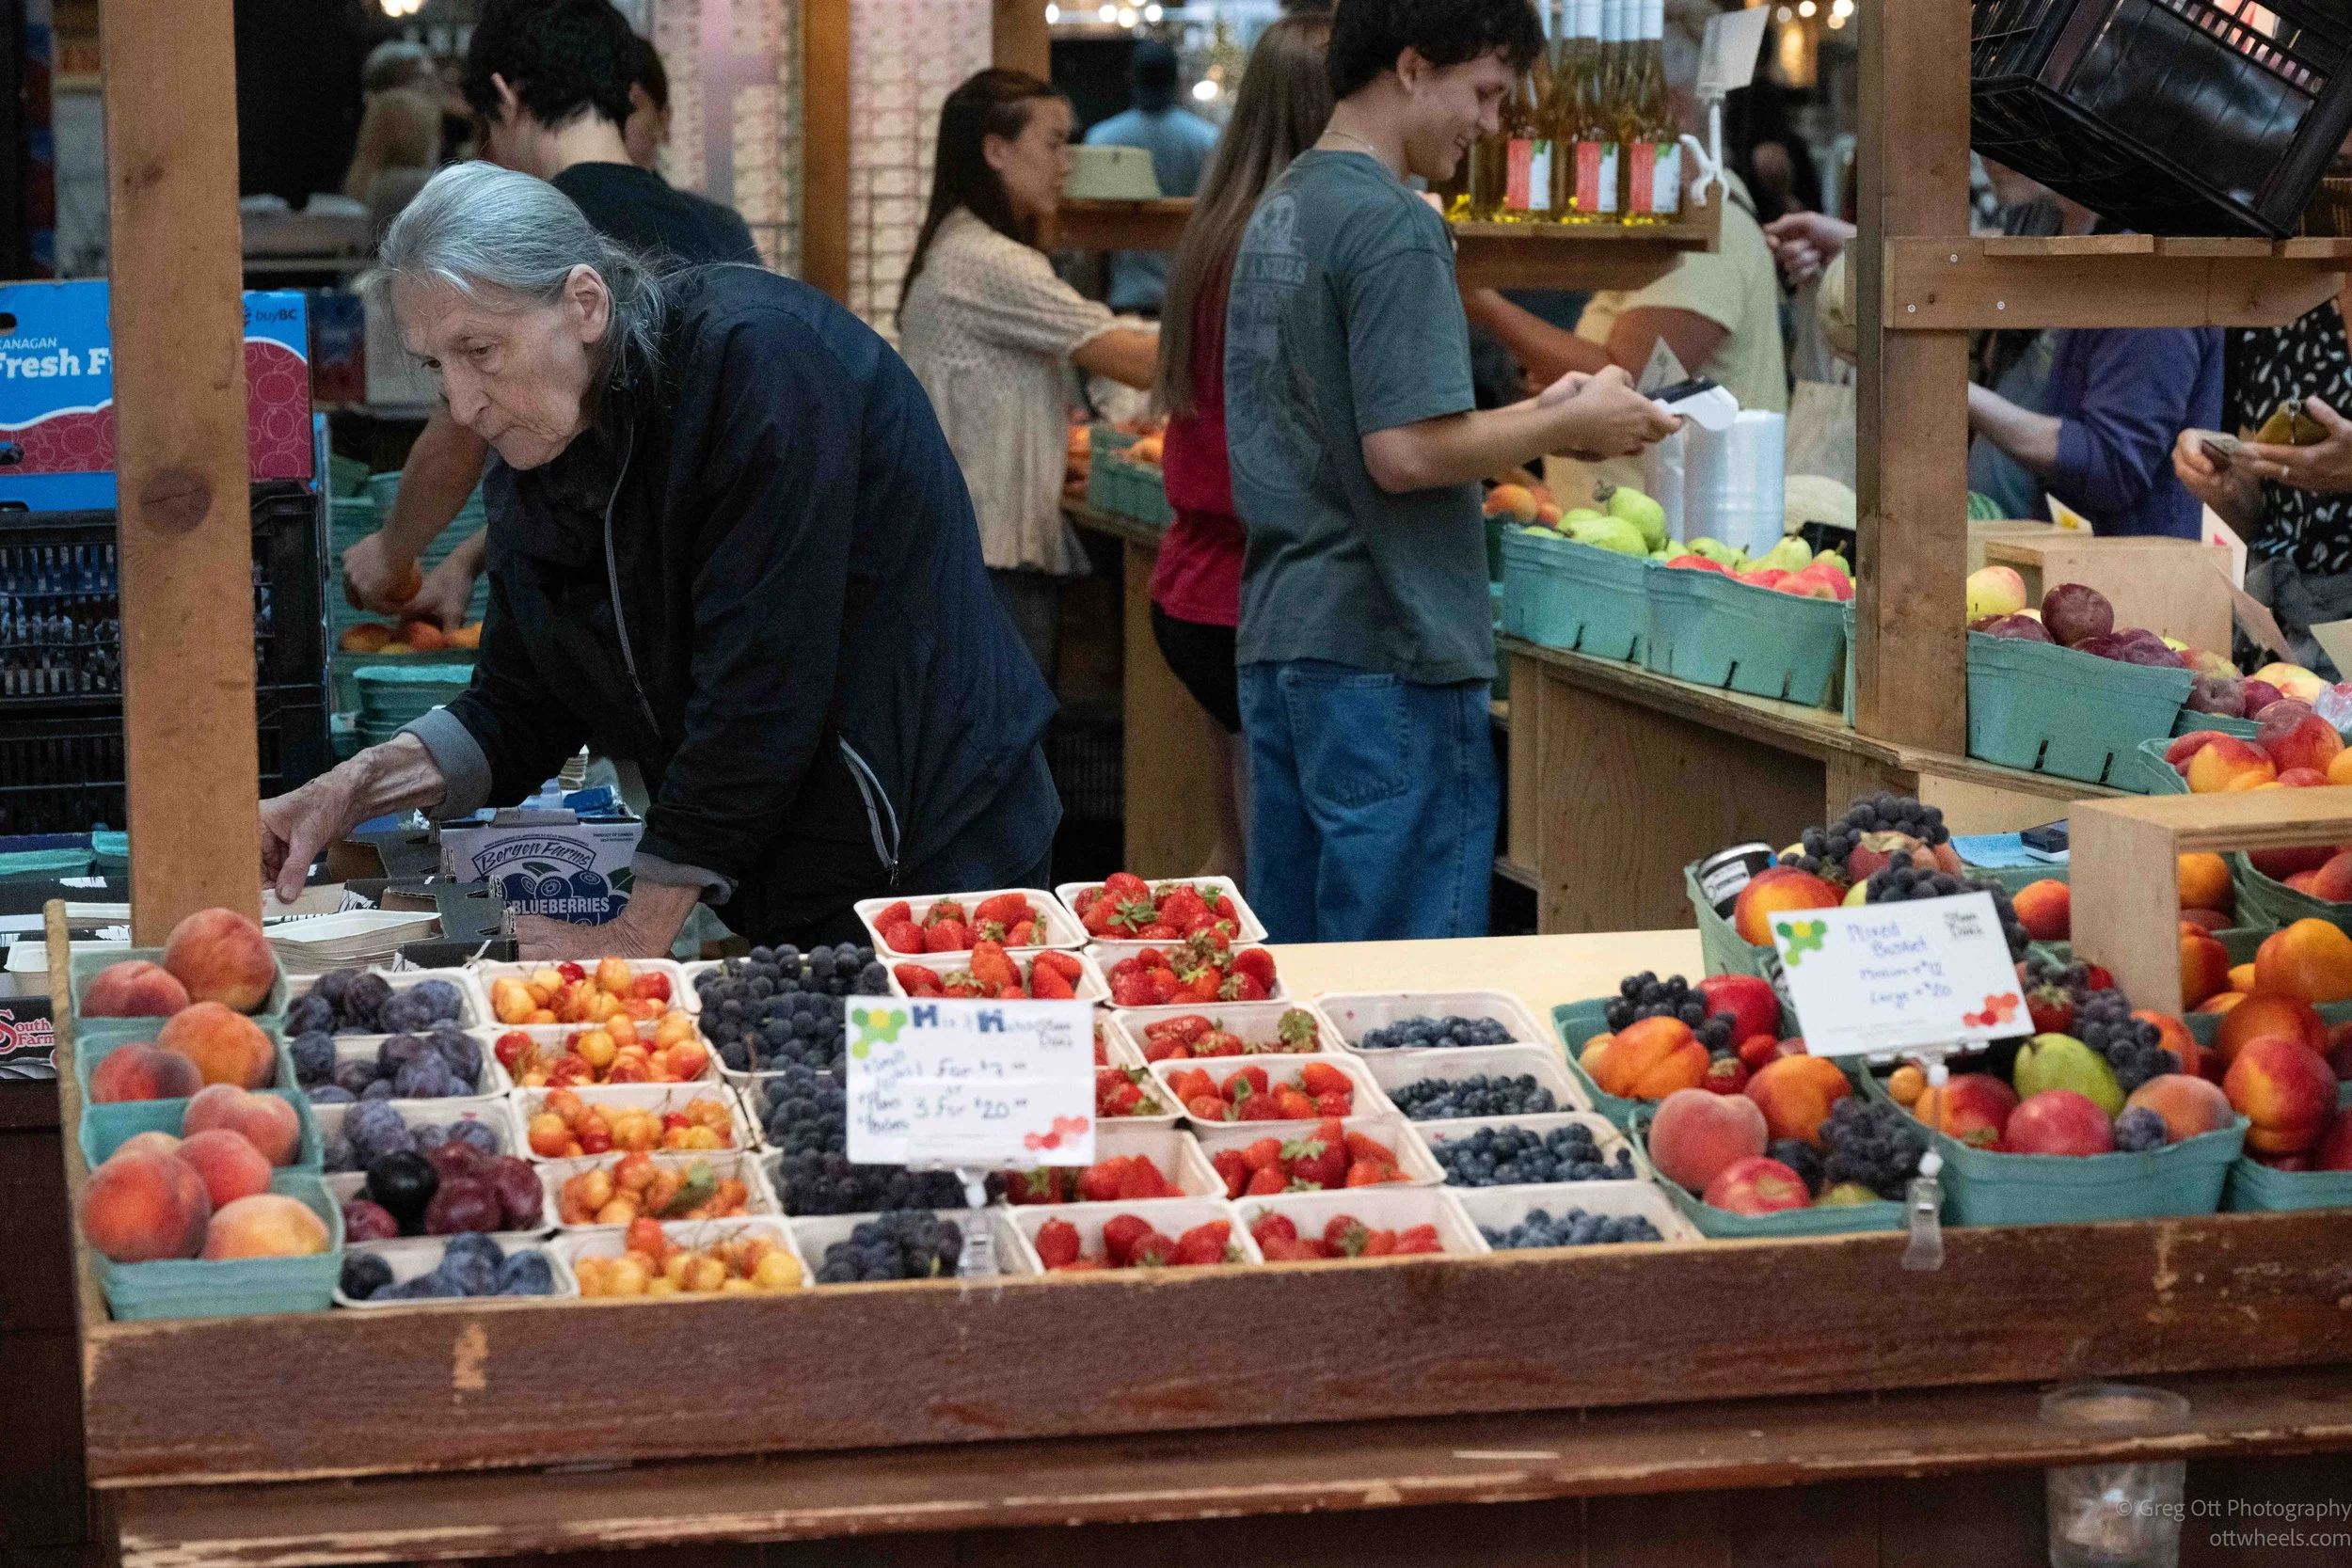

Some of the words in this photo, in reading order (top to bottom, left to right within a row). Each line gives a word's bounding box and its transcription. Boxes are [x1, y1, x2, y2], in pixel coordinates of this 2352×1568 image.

[255, 309, 297, 324] buyBC
[0, 337, 57, 350] ANAGAN
[87, 347, 112, 375] F
[476, 842, 542, 872] Bergen
[540, 841, 591, 866] Farms
[514, 896, 611, 915] BLUEBERRIES
